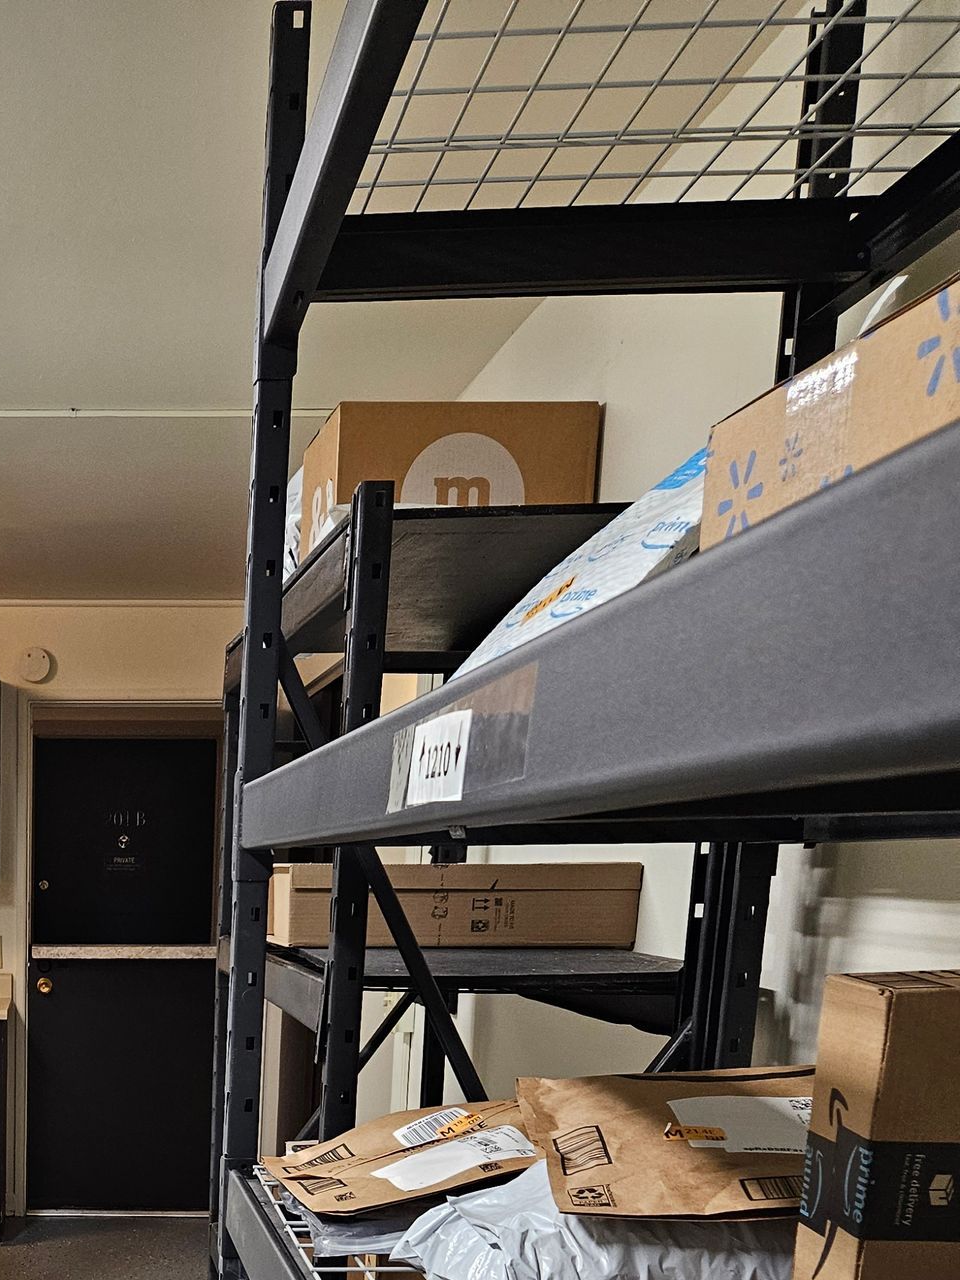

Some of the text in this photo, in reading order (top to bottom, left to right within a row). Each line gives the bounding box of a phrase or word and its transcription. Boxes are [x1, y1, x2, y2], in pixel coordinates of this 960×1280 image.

[425, 741, 451, 779] 1210
[852, 1145, 876, 1223] prime
[901, 1154, 926, 1226] free delivery
